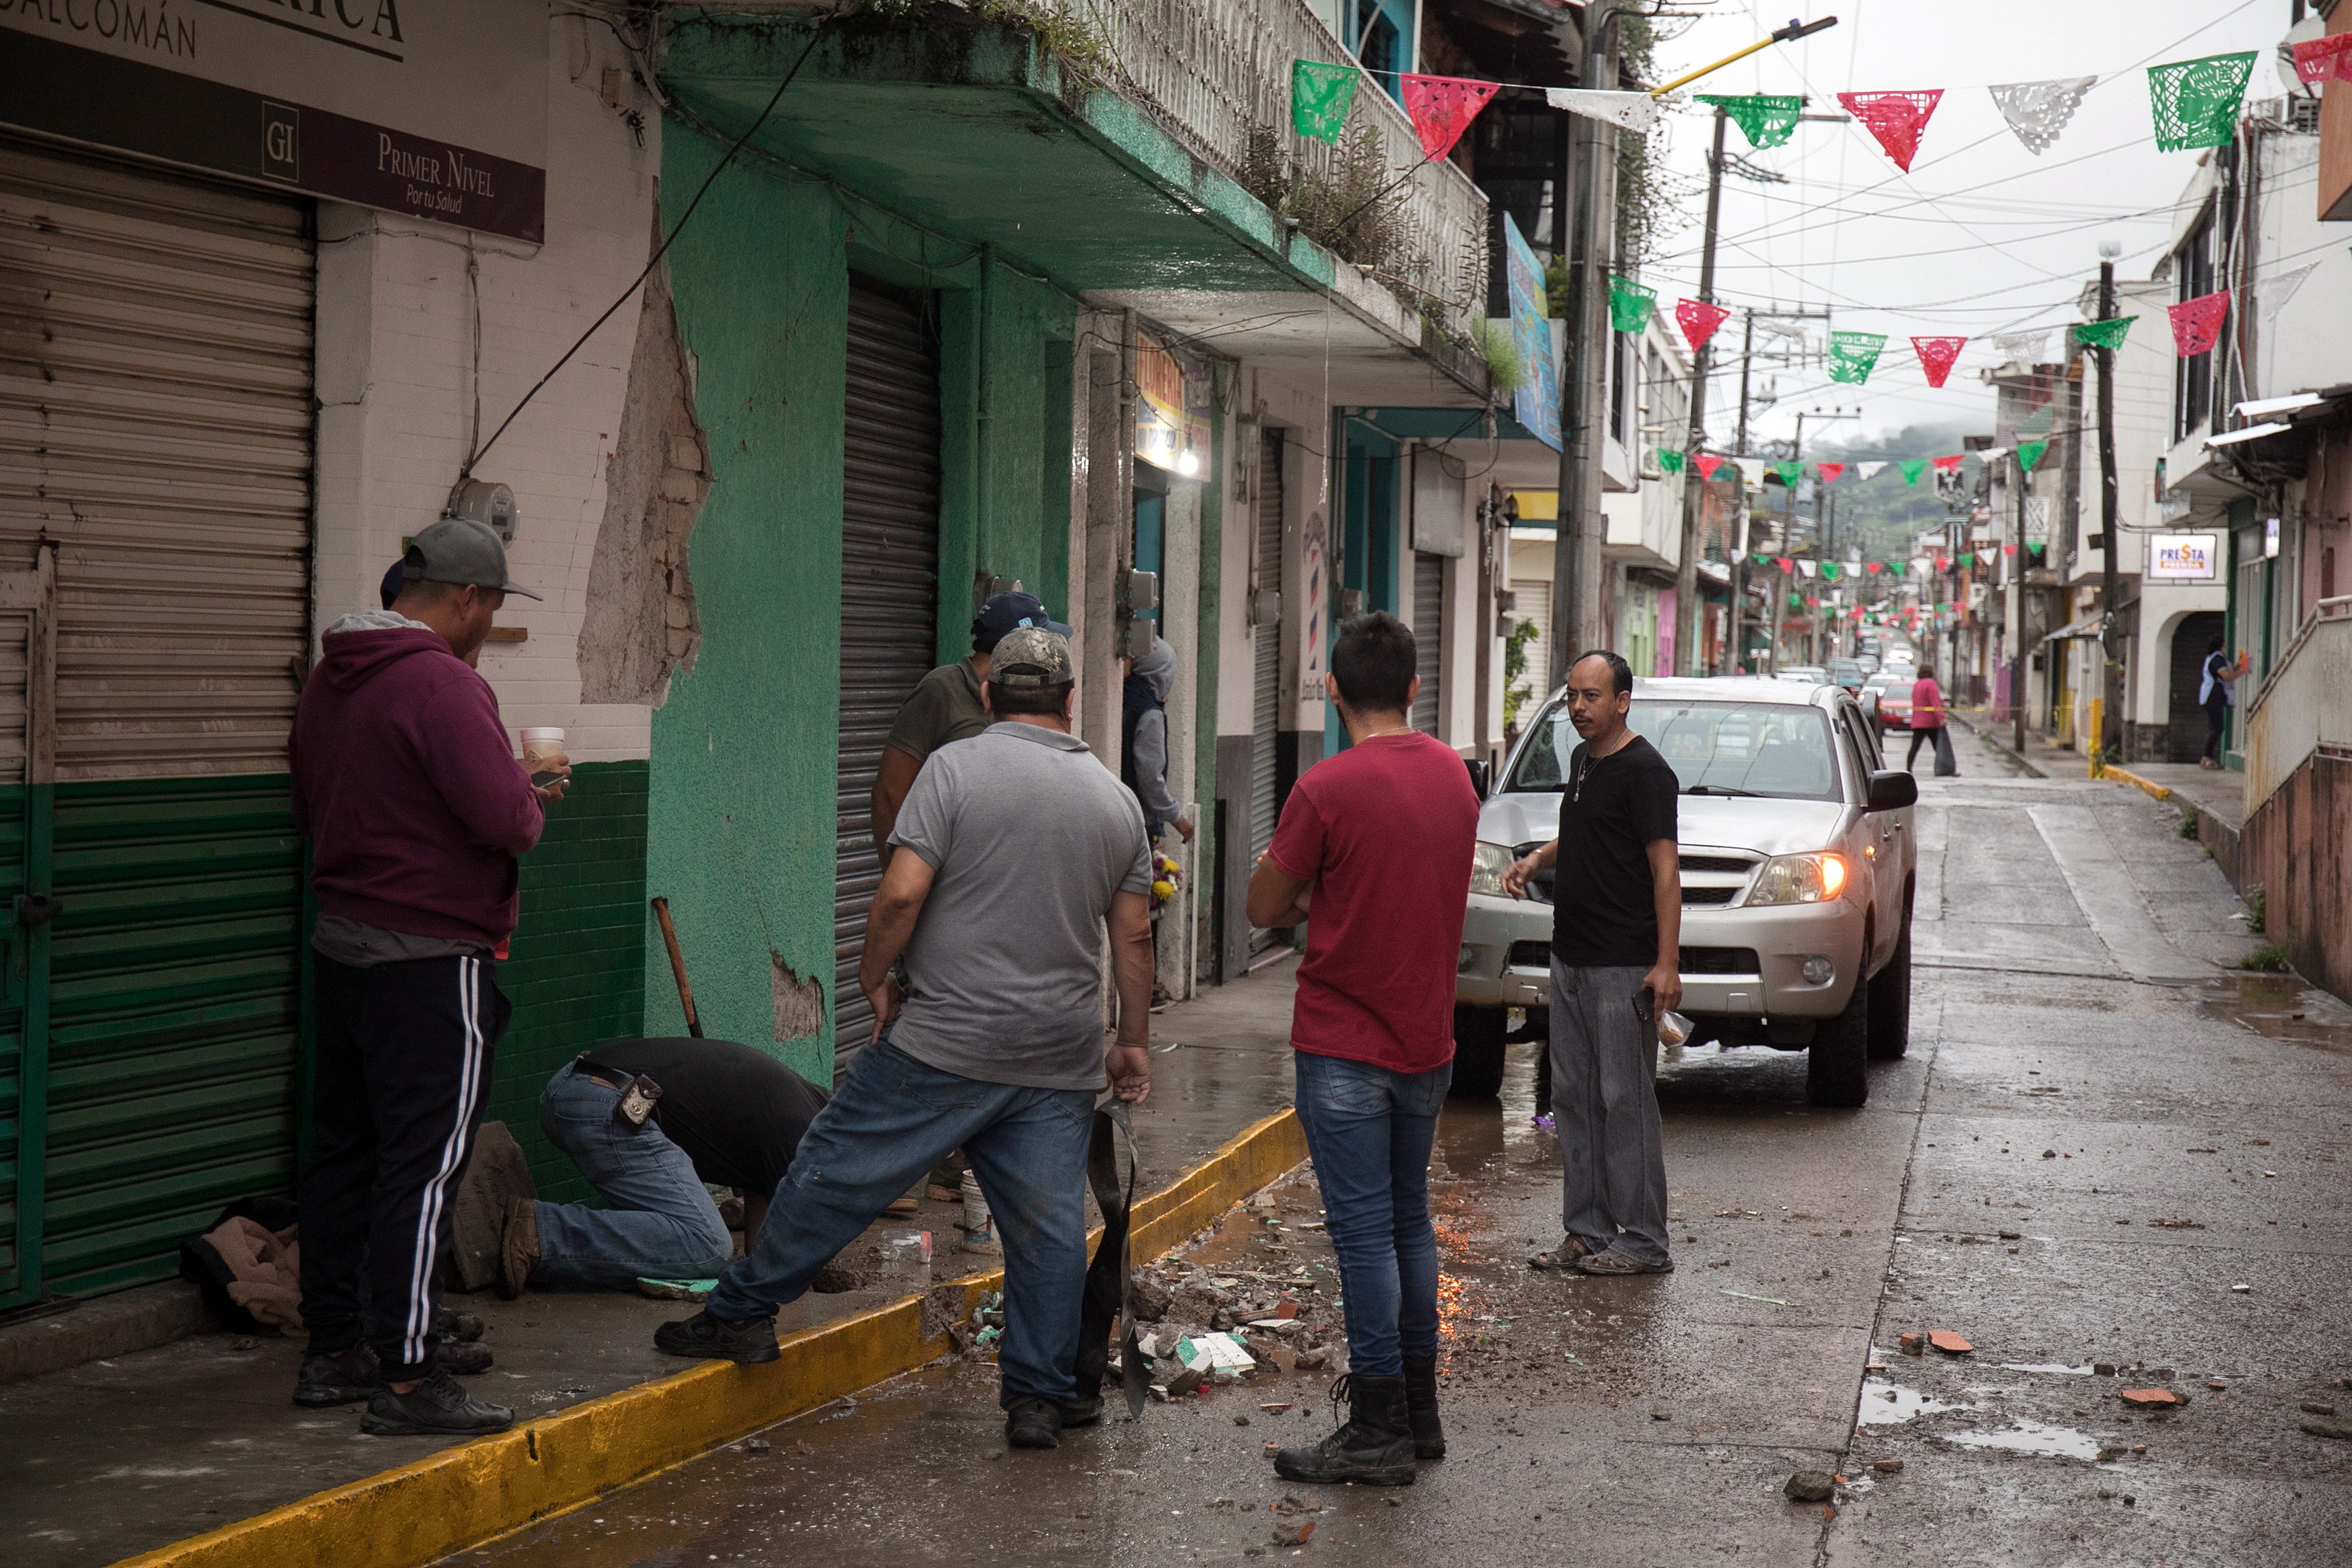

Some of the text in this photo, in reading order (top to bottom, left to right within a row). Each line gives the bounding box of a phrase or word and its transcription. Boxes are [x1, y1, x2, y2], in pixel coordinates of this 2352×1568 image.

[0, 0, 196, 60] ALCOMÁN
[267, 121, 294, 163] GI
[406, 184, 462, 214] Por tu Salud
